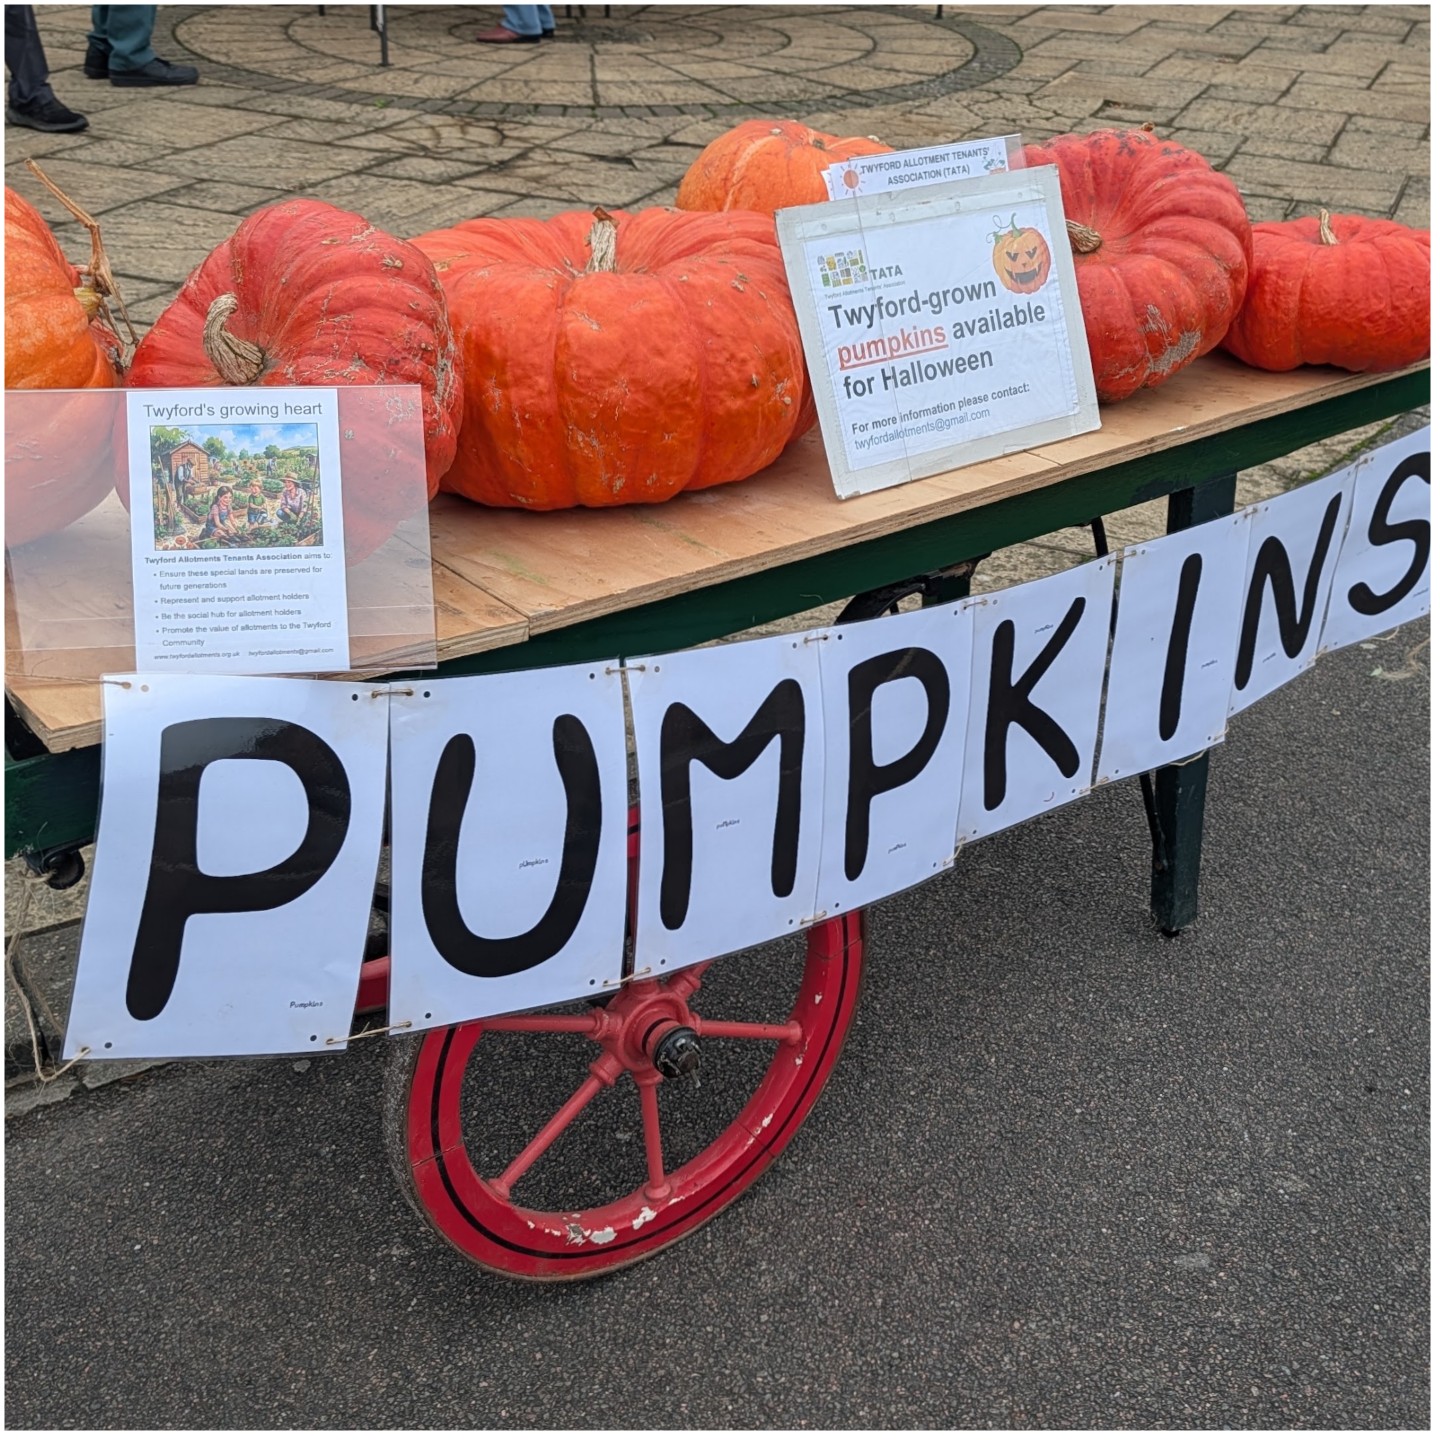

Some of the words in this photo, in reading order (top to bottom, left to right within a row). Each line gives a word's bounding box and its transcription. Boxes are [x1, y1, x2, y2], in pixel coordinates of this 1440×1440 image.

[861, 160, 902, 175] TWYFORD
[903, 153, 950, 168] ALLOTMENT
[952, 147, 990, 160] TENANTS'
[887, 169, 942, 185] ASSOCIATION
[943, 164, 970, 179] (TATA)
[869, 265, 904, 280] TATA
[828, 280, 997, 329] Twyford-grown
[838, 325, 947, 367] pumpkins
[952, 302, 1046, 340] available
[843, 376, 875, 400] for
[881, 350, 993, 391] Halloween
[143, 404, 215, 420] Twyford's
[220, 403, 279, 419] growing
[284, 402, 322, 415] heart
[852, 423, 869, 435] For
[872, 415, 897, 430] more
[899, 401, 956, 423] information
[958, 393, 989, 411] please
[991, 383, 1030, 400] contact:
[144, 557, 177, 565] Twyford
[222, 554, 254, 562] Tenants
[160, 570, 186, 578] Ensure
[210, 568, 236, 577] special
[274, 566, 310, 575] preserved
[160, 583, 181, 591] future
[183, 582, 227, 591] generations
[160, 596, 199, 605] Represent
[217, 595, 245, 604] support
[247, 594, 281, 602] allotment
[239, 609, 272, 617] allotment
[240, 623, 278, 631] allotments
[302, 621, 332, 630] Twyford
[162, 639, 205, 647] Community
